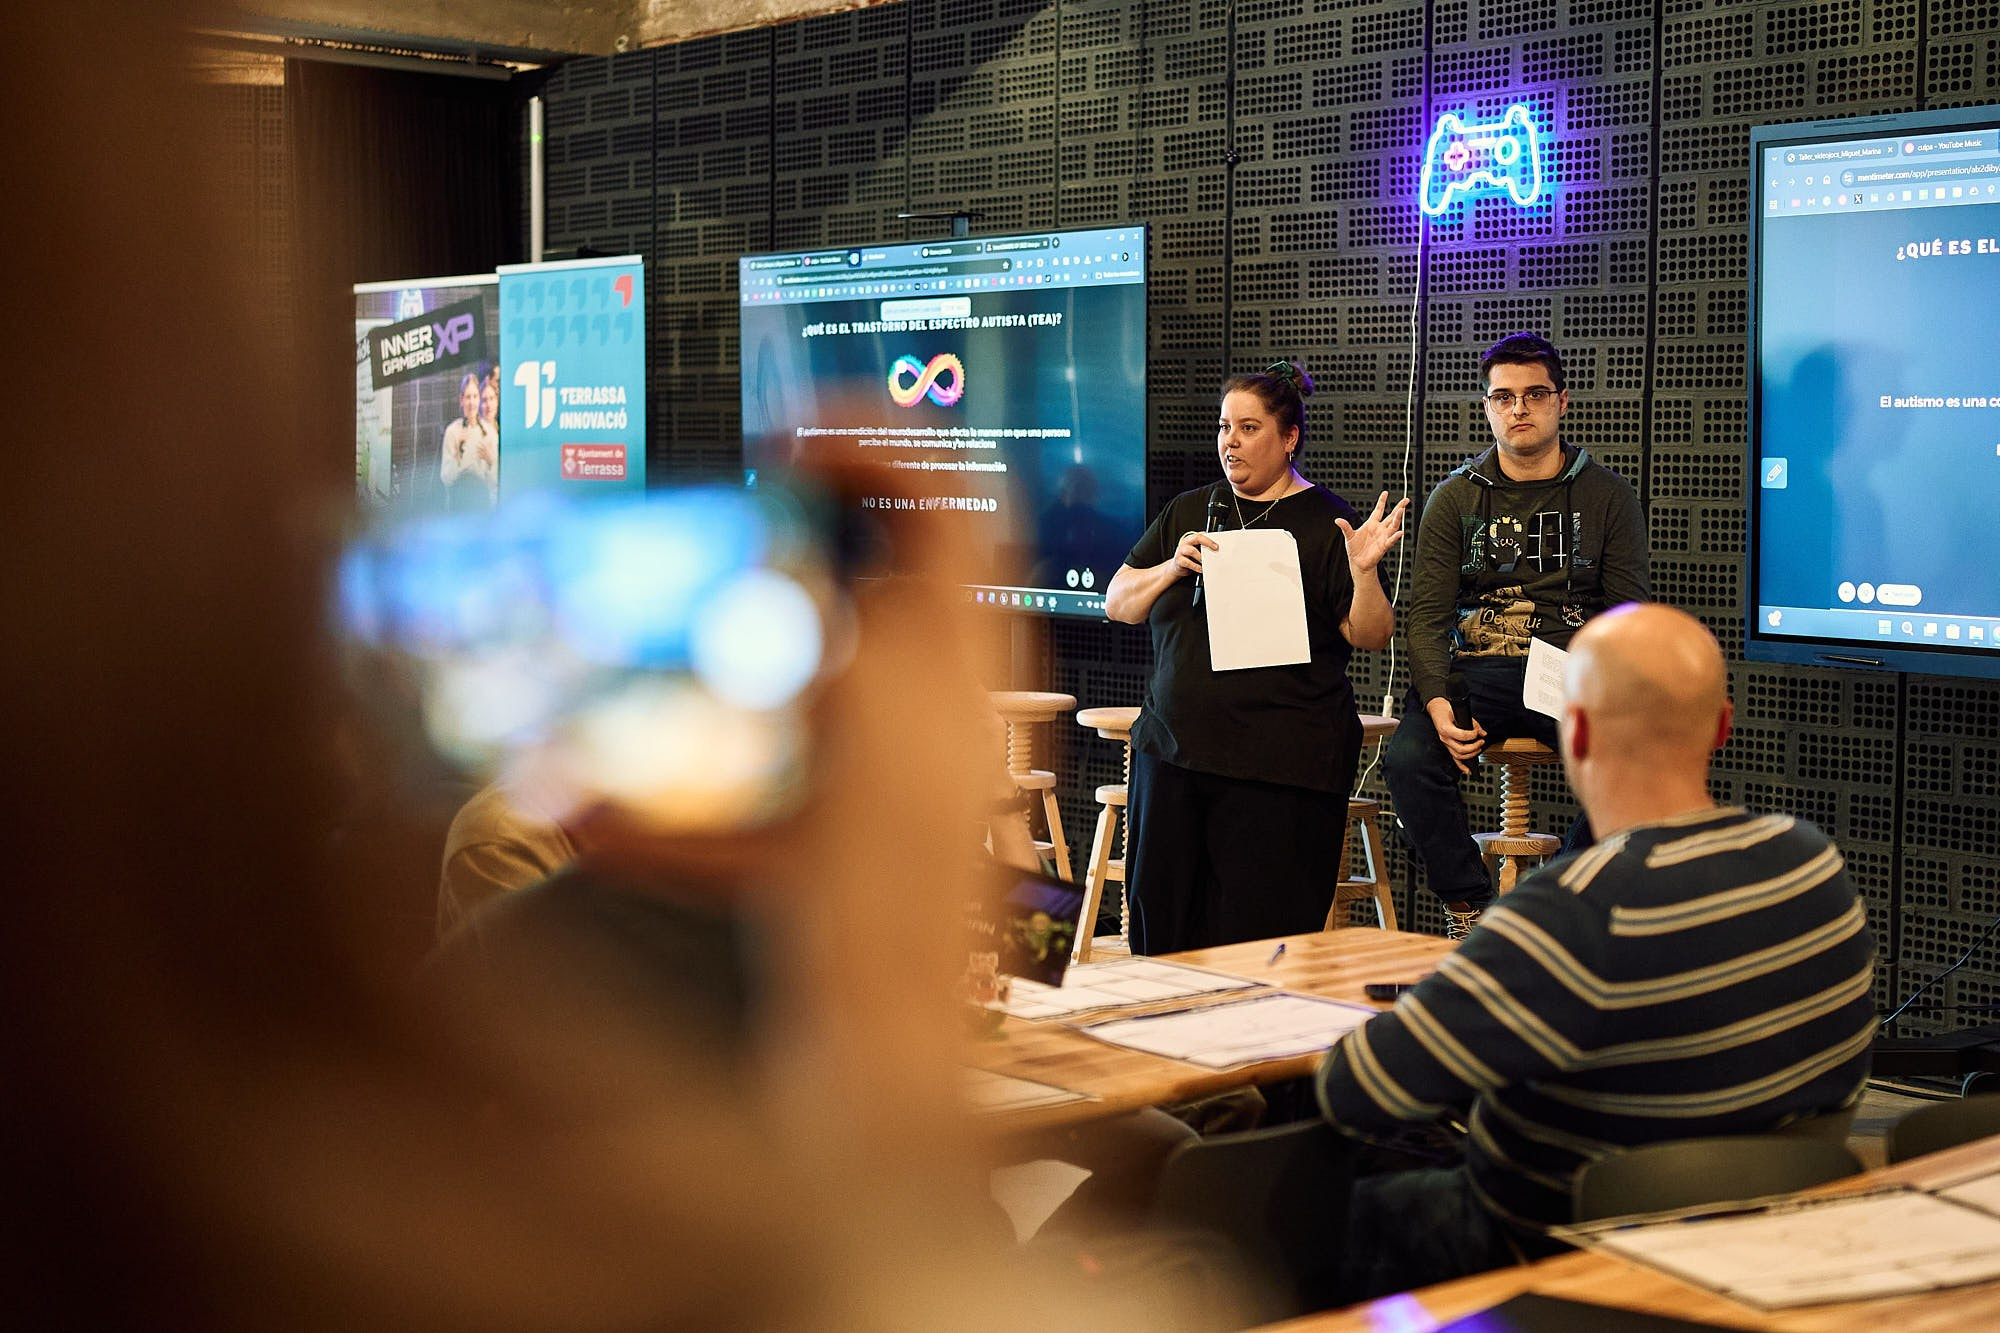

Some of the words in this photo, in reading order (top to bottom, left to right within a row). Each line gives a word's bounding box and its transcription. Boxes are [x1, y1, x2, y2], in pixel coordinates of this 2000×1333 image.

[1938, 141, 1964, 150] YouTube
[1964, 140, 1983, 148] Music
[1896, 238, 1943, 261] ¿QUÉ
[1948, 240, 1972, 255] ES
[1977, 238, 2000, 254] EL
[802, 322, 825, 338] ¿QUÉ
[825, 323, 838, 335] ES
[839, 322, 851, 335] EL
[852, 320, 908, 334] TRASTORNO
[908, 319, 928, 331] DEL
[928, 316, 980, 331] ESPECTRO
[981, 313, 1026, 328] AUTISTA
[1027, 312, 1062, 328] (TEA)?
[381, 325, 433, 361] INNER
[433, 313, 475, 359] XP
[382, 347, 435, 377] GAMERS
[560, 386, 627, 406] TERRASSA
[1880, 395, 1892, 408] El
[1894, 395, 1945, 408] autismo
[1946, 397, 1960, 408] es
[1962, 397, 1987, 408] una
[560, 406, 627, 430] INNOVACIÓ
[1042, 429, 1071, 440] persona
[614, 450, 624, 459] de
[577, 460, 624, 476] Terrassa
[862, 497, 876, 509] NO
[878, 497, 892, 510] ES
[894, 498, 916, 510] UNA
[919, 496, 998, 512] ENFERMEDAD
